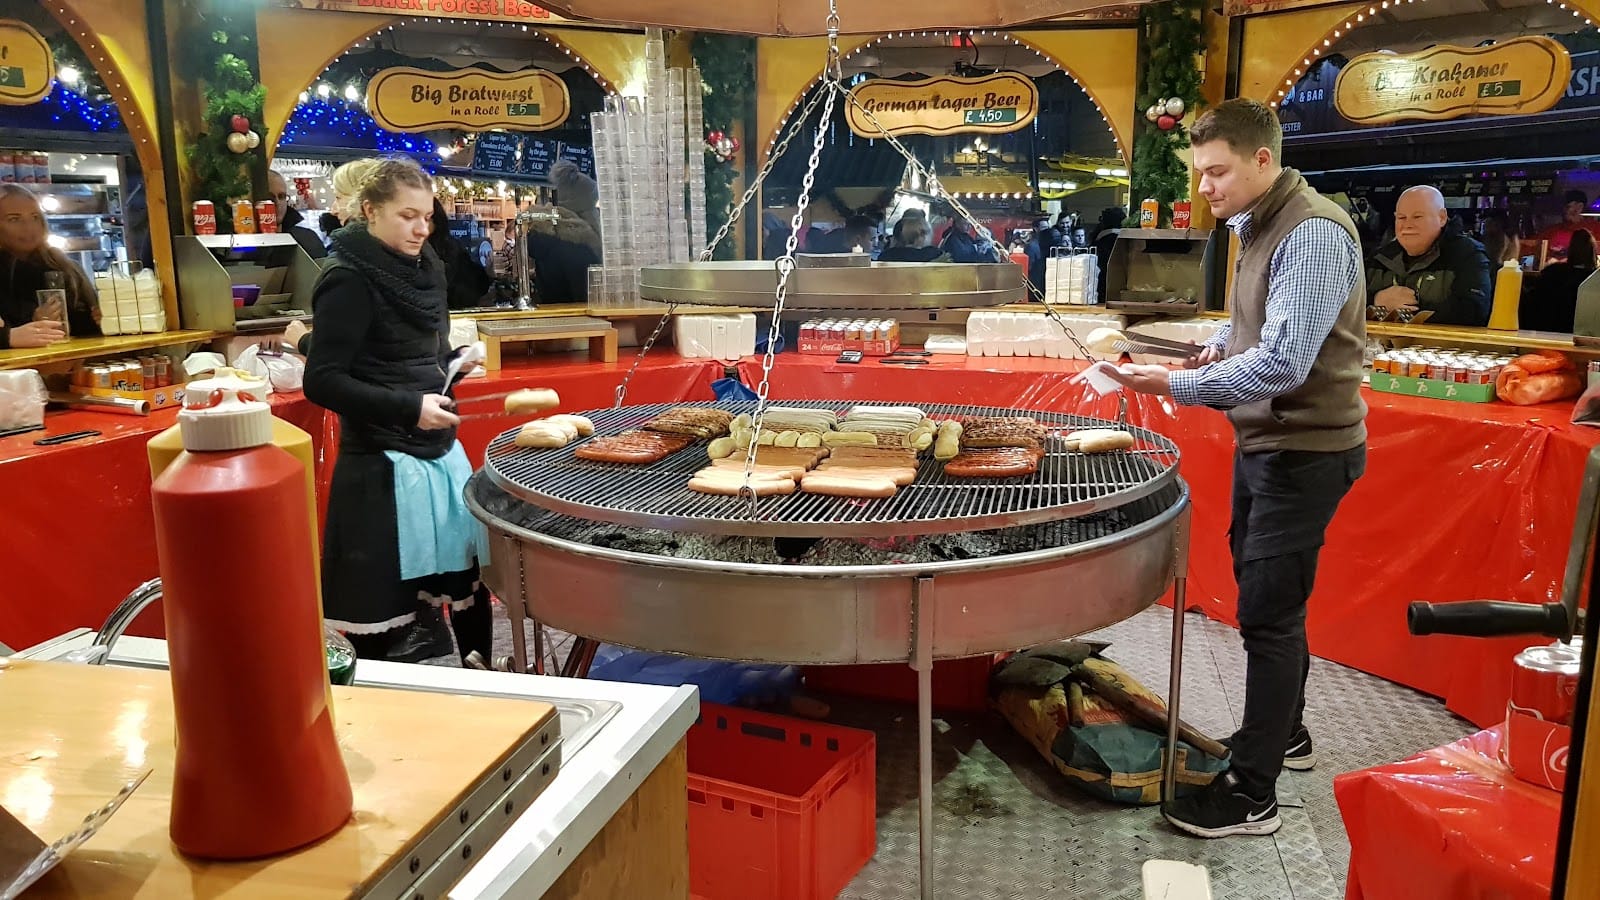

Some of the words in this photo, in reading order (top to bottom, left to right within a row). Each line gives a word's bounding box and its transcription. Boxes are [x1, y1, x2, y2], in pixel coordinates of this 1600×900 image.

[427, 0, 499, 15] Forest
[411, 84, 442, 105] Big
[448, 85, 534, 103] Bratwurst
[1299, 91, 1305, 103] &
[1306, 89, 1324, 101] BAR
[1436, 87, 1467, 99] Roll
[1494, 82, 1504, 96] 5
[519, 104, 529, 115] 5
[863, 98, 927, 114] German
[932, 95, 978, 112] Lager
[983, 92, 1021, 109] Beer
[451, 106, 460, 116] in
[475, 105, 500, 116] Roll
